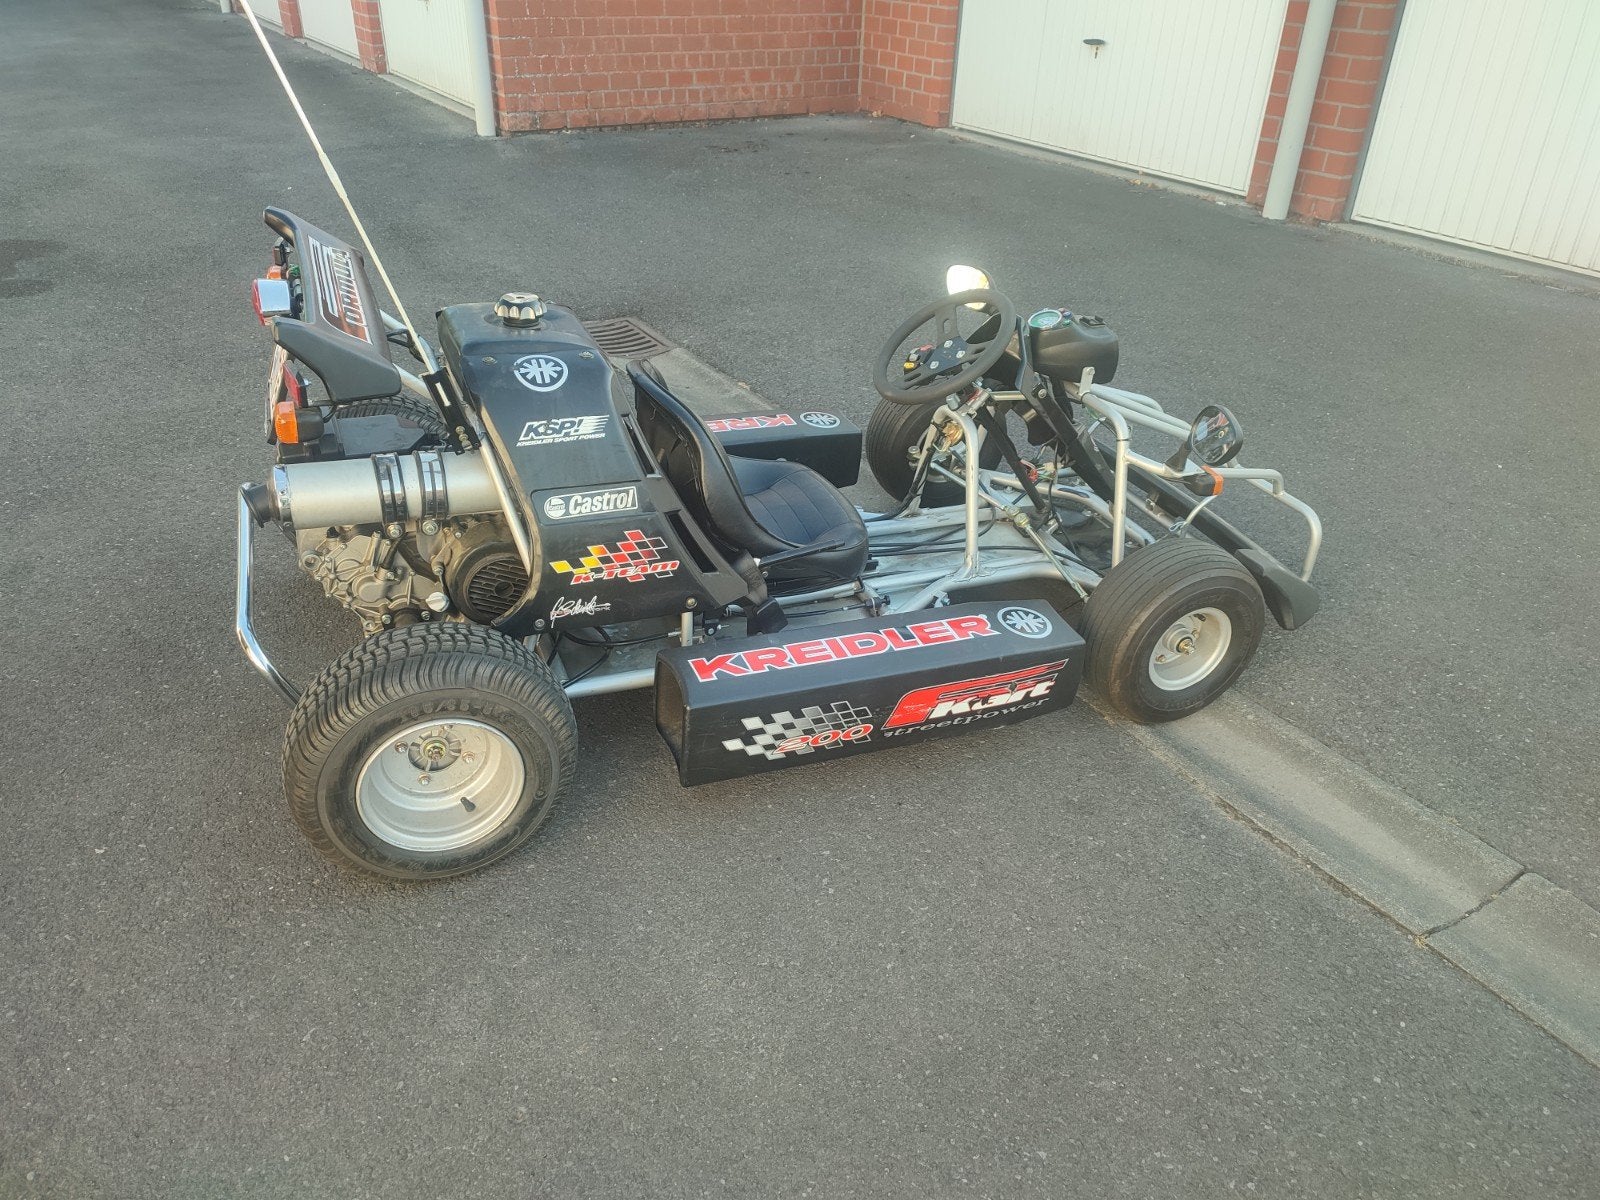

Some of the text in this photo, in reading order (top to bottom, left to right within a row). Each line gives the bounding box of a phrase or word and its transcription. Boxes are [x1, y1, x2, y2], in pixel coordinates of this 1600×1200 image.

[568, 489, 634, 515] Castrol
[687, 615, 1001, 683] KREIDLER
[771, 723, 874, 756] 200
